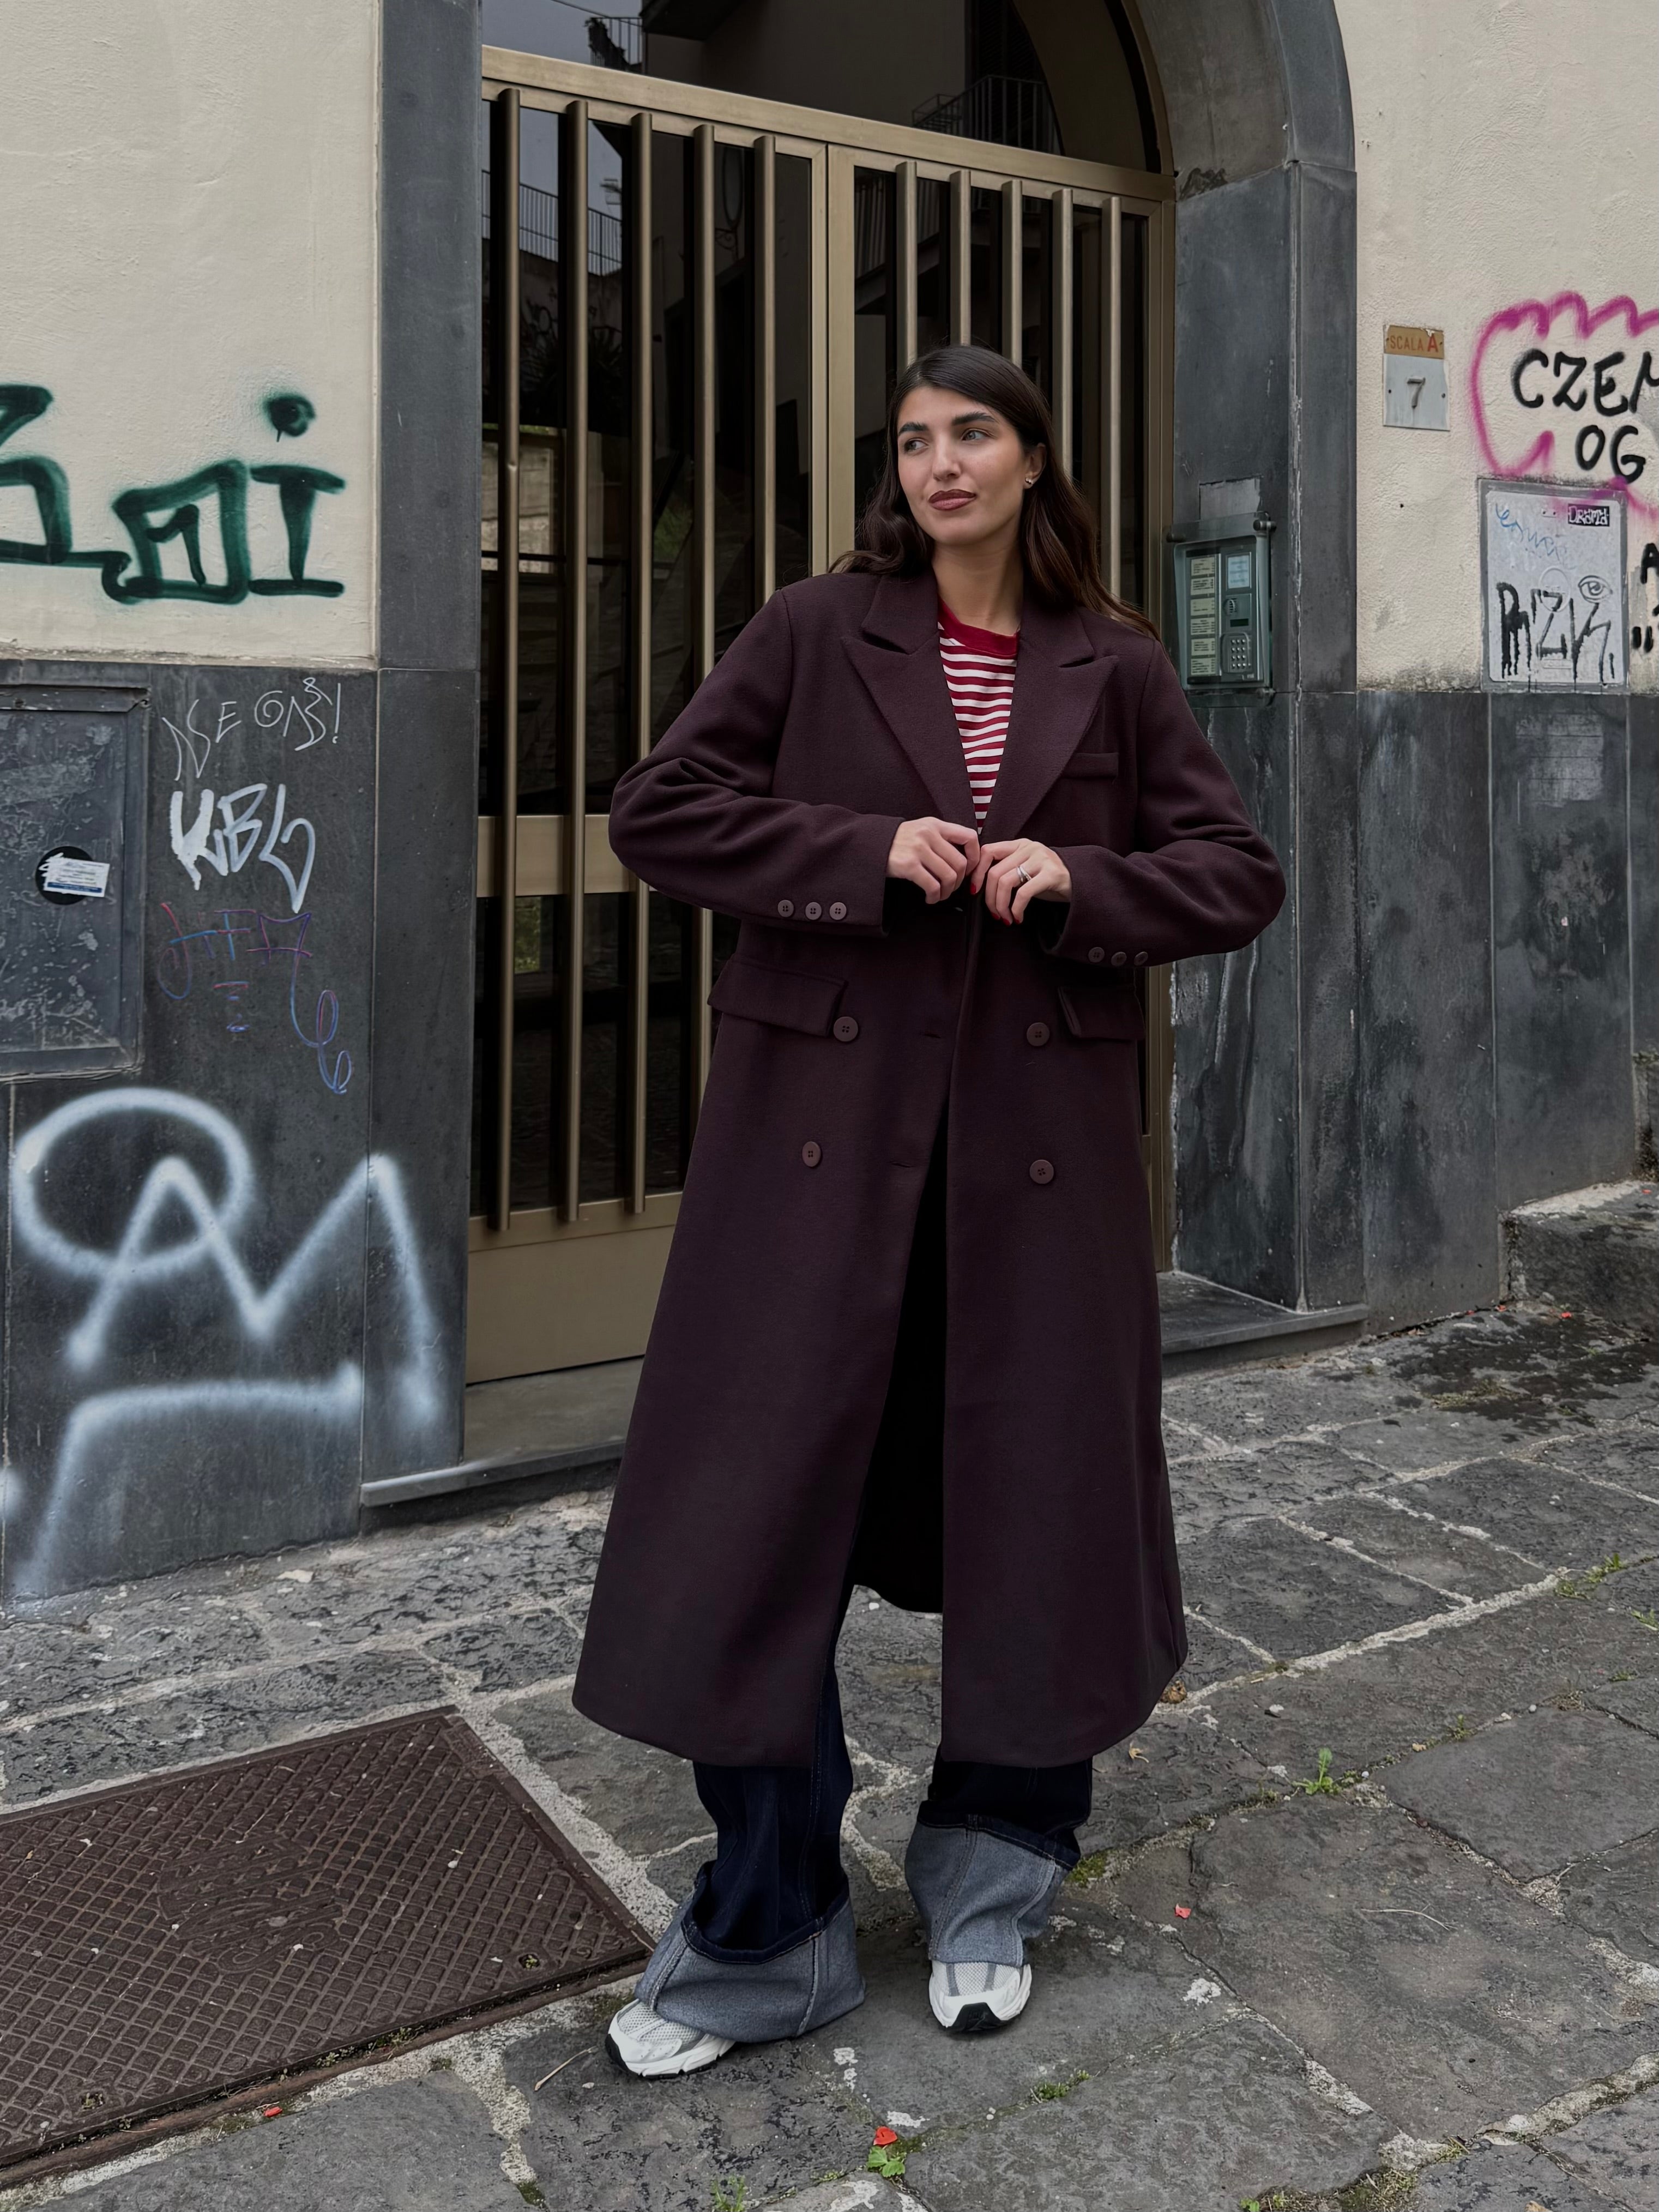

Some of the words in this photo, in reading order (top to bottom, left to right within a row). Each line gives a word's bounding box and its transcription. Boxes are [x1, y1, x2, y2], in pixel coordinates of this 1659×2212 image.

[1390, 335, 1424, 351] SCALA
[1427, 332, 1439, 353] A
[1407, 377, 1426, 409] 7
[1575, 424, 1646, 484] OG
